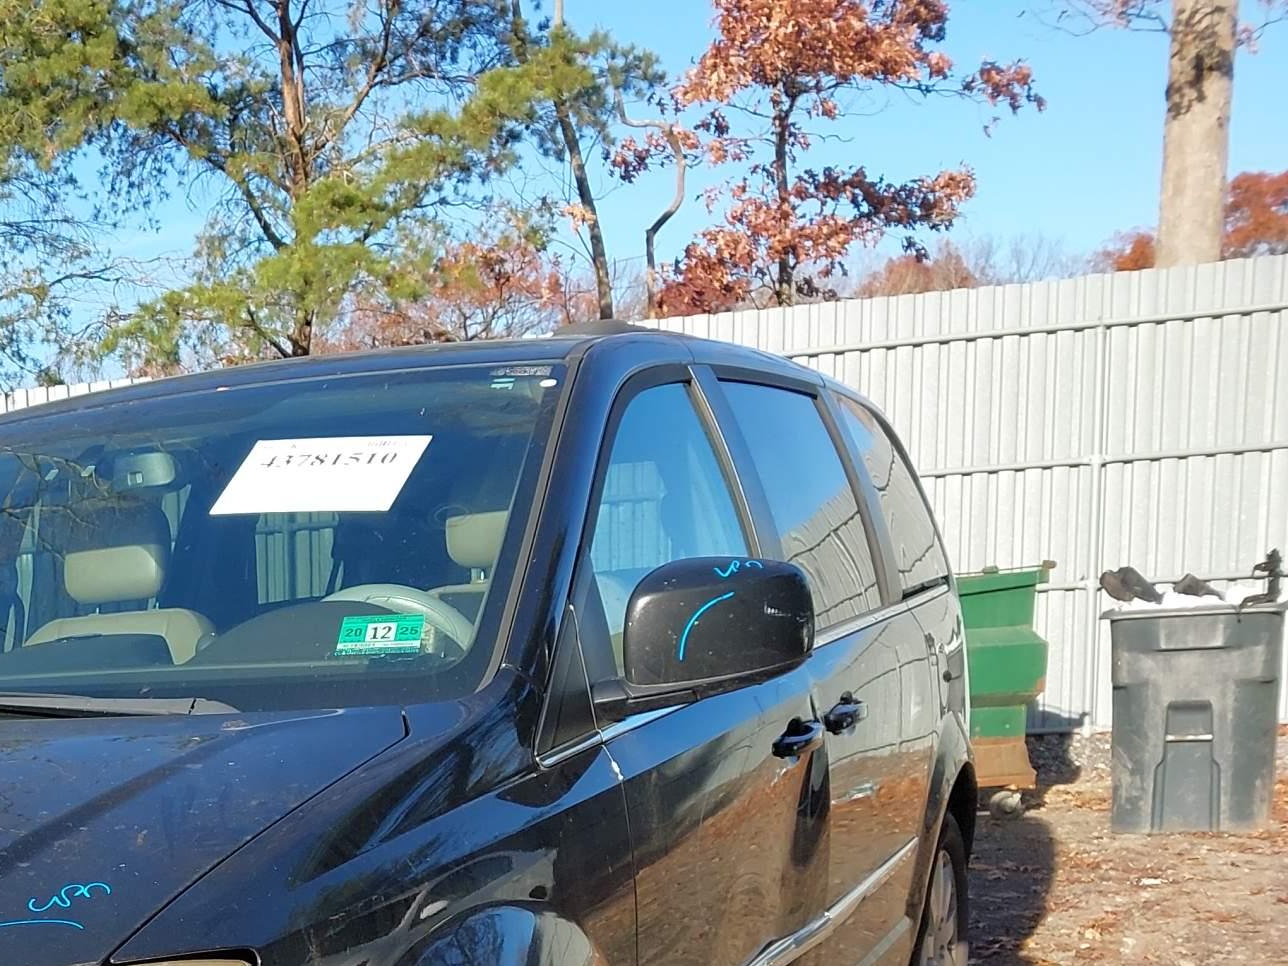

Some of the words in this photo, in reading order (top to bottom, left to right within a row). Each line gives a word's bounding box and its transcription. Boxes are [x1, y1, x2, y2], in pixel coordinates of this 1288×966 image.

[344, 628, 363, 638] 20
[370, 625, 393, 640] 12
[400, 626, 418, 635] 25
